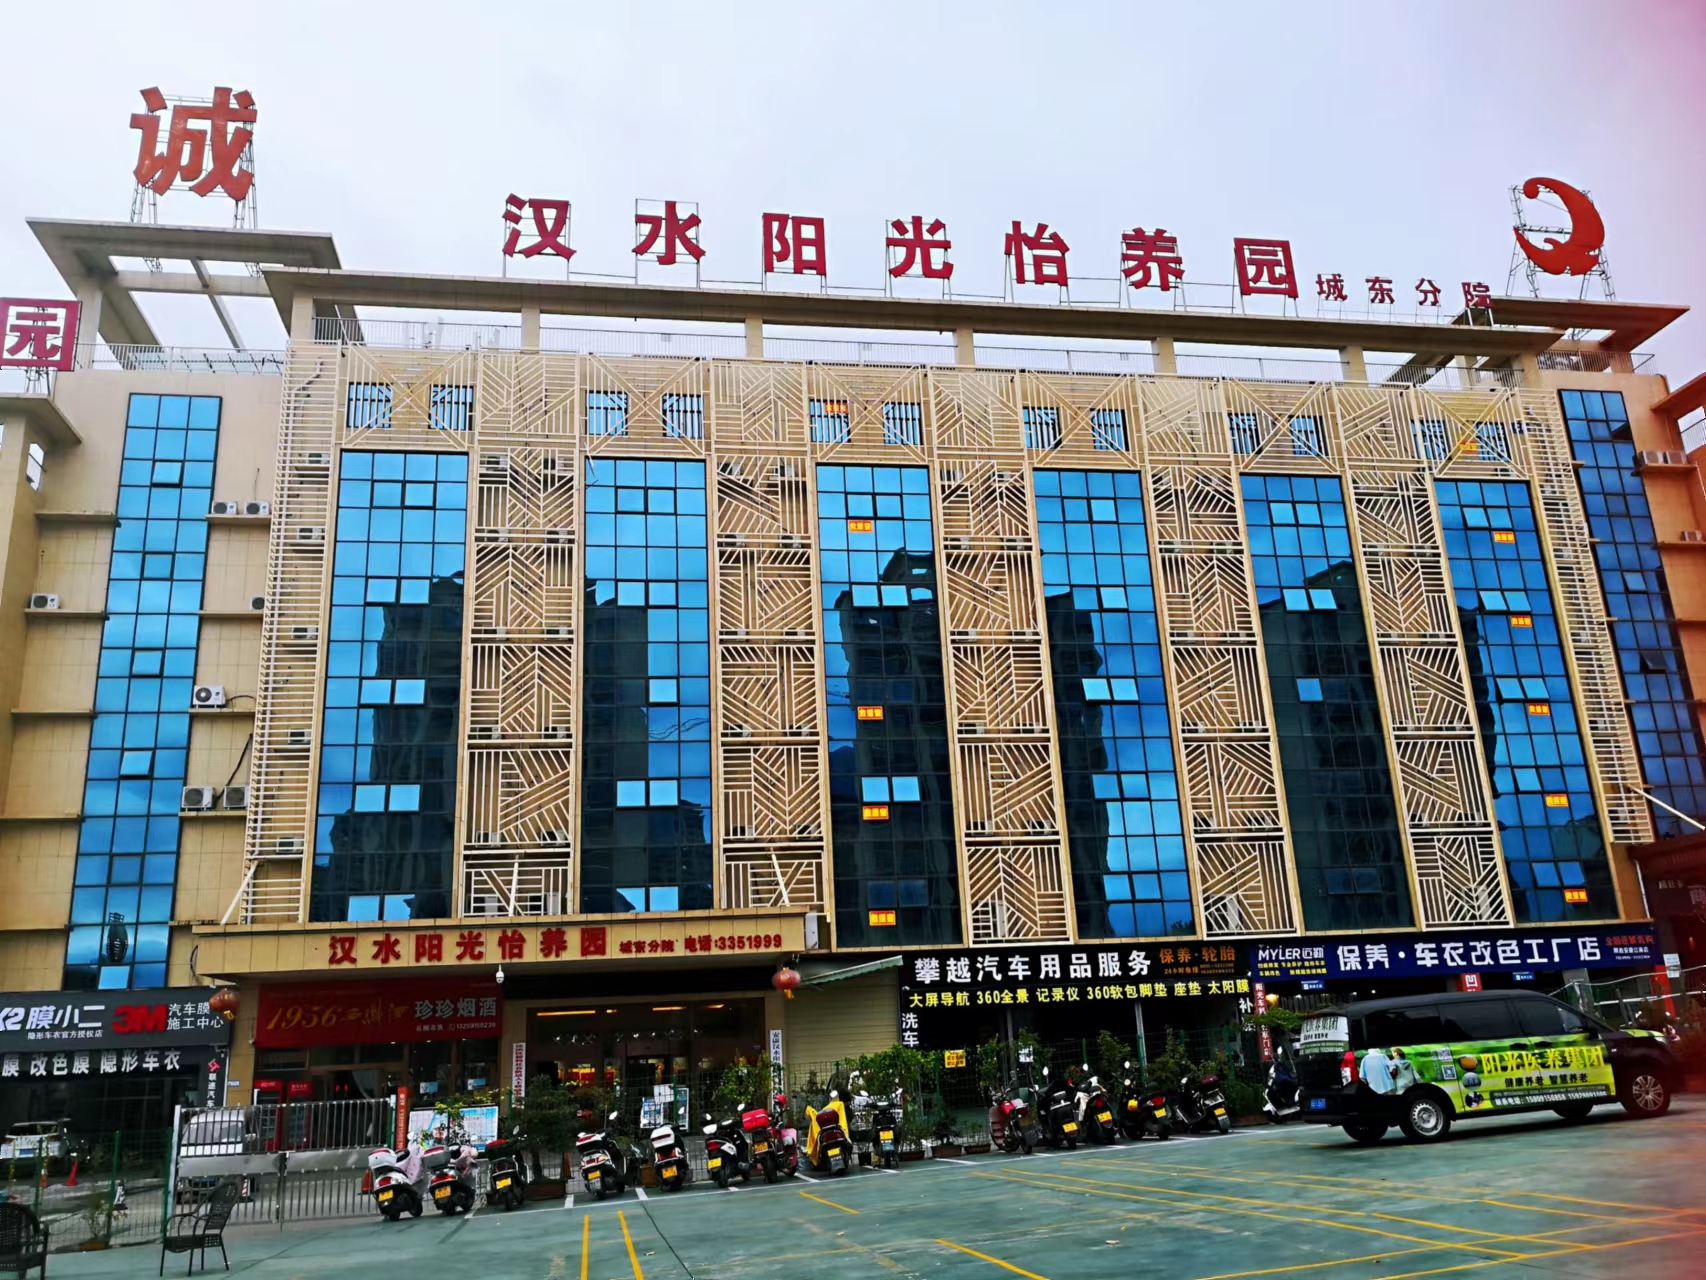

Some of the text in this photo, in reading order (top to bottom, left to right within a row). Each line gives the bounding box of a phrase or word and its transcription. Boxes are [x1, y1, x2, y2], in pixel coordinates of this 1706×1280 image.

[130, 86, 258, 201] 诚
[502, 193, 1299, 298] 汉水阳光怡养园
[1316, 273, 1493, 309] 城东分院
[0, 297, 82, 371] 园
[329, 926, 607, 965] 汉水阳光怡养园
[619, 939, 675, 954] 城东分院
[1258, 944, 1301, 961] MYLER
[1337, 936, 1600, 971] 保养·车衣改色工厂店
[914, 950, 1152, 984] 攀越汽车用品服务
[909, 979, 1250, 1008] 大屏导航 360全景 记录仪 360软包脚垫 座垫 太阳膜
[26, 1004, 105, 1030] 膜小二
[112, 1004, 168, 1034] 3M
[167, 1014, 224, 1031] 施工中心
[168, 1002, 211, 1016] 汽车膜
[414, 997, 497, 1020] 珍珍烟酒
[27, 1029, 104, 1040] 隐形车衣官方授权店
[901, 1012, 919, 1047] 洗车
[2, 1047, 182, 1077] 膜 改色膜 隐形车衣
[1480, 1046, 1605, 1075] 阳光医养集团
[1505, 1073, 1588, 1088] 健康养老 智慧养老
